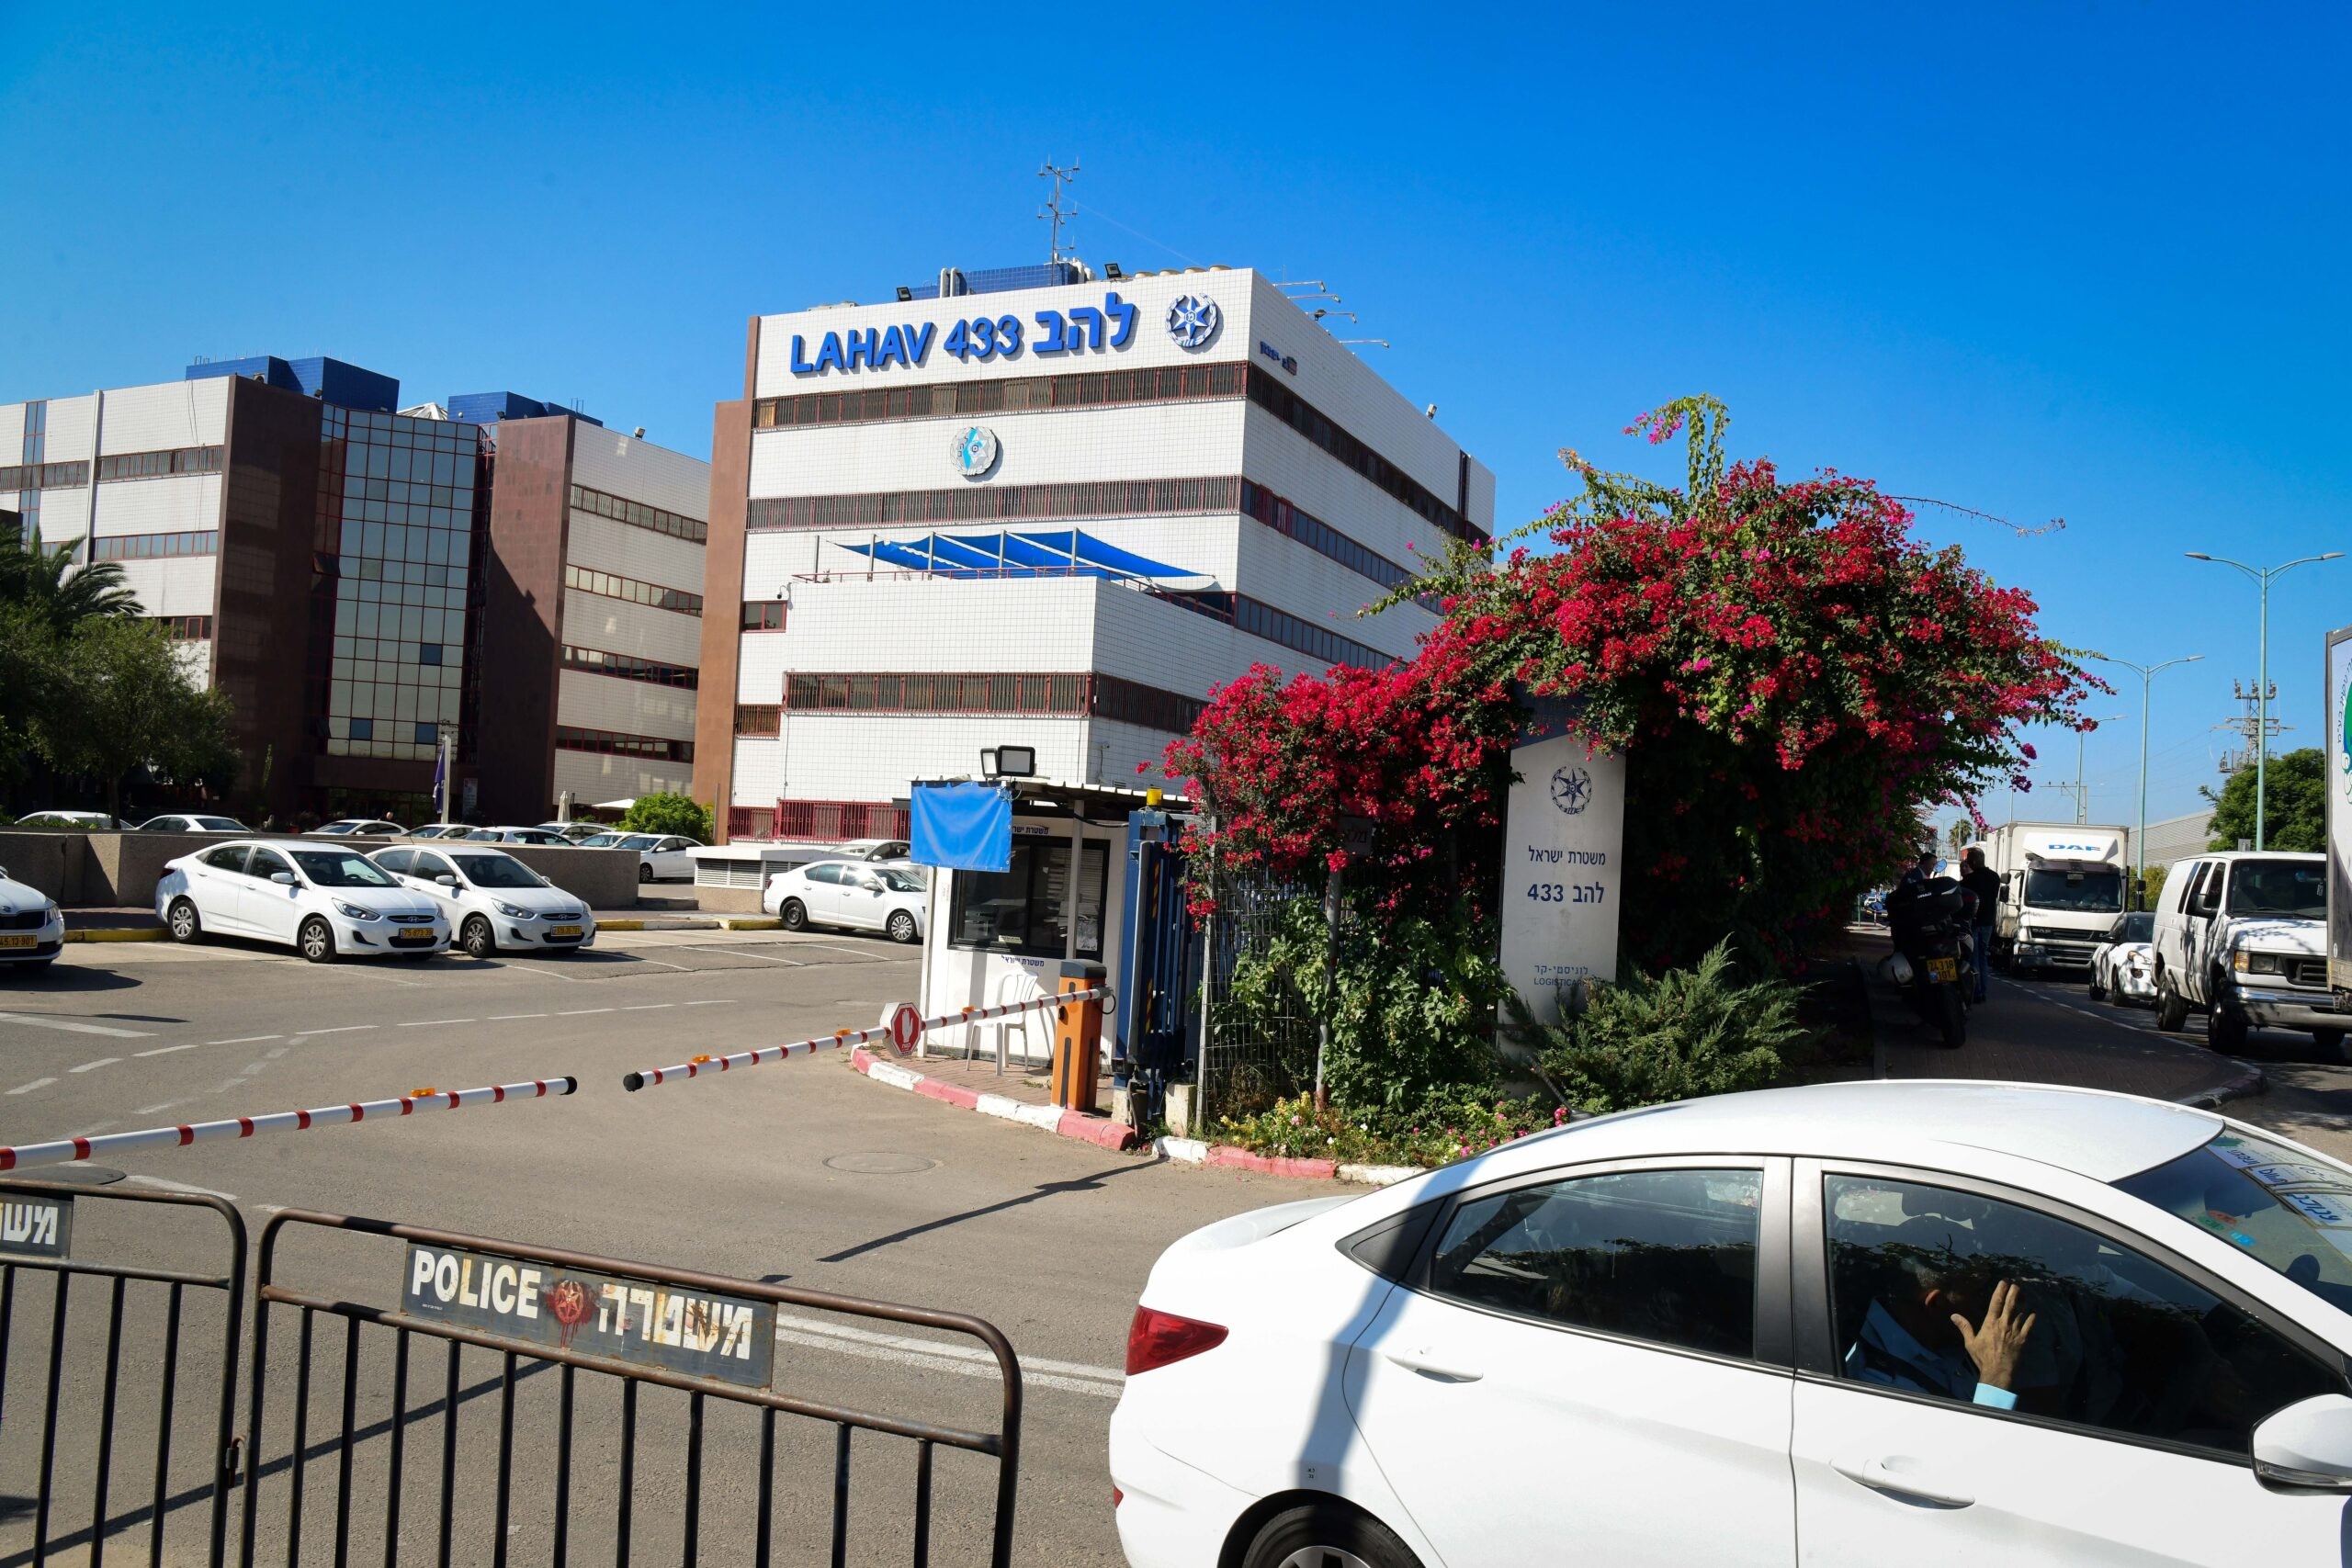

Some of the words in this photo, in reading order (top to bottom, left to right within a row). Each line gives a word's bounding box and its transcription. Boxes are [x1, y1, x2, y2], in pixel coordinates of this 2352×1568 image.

[790, 321, 935, 373] LAHAV
[944, 314, 1021, 359] 433
[1033, 291, 1136, 354] להב
[1528, 844, 1563, 863] ישראל
[1567, 851, 1606, 865] משטרת
[1527, 884, 1564, 902] 433
[1572, 881, 1605, 903] להב
[1021, 957, 1045, 967] משטרת
[412, 1250, 542, 1319] POLICE
[598, 1282, 753, 1360] משטרה
